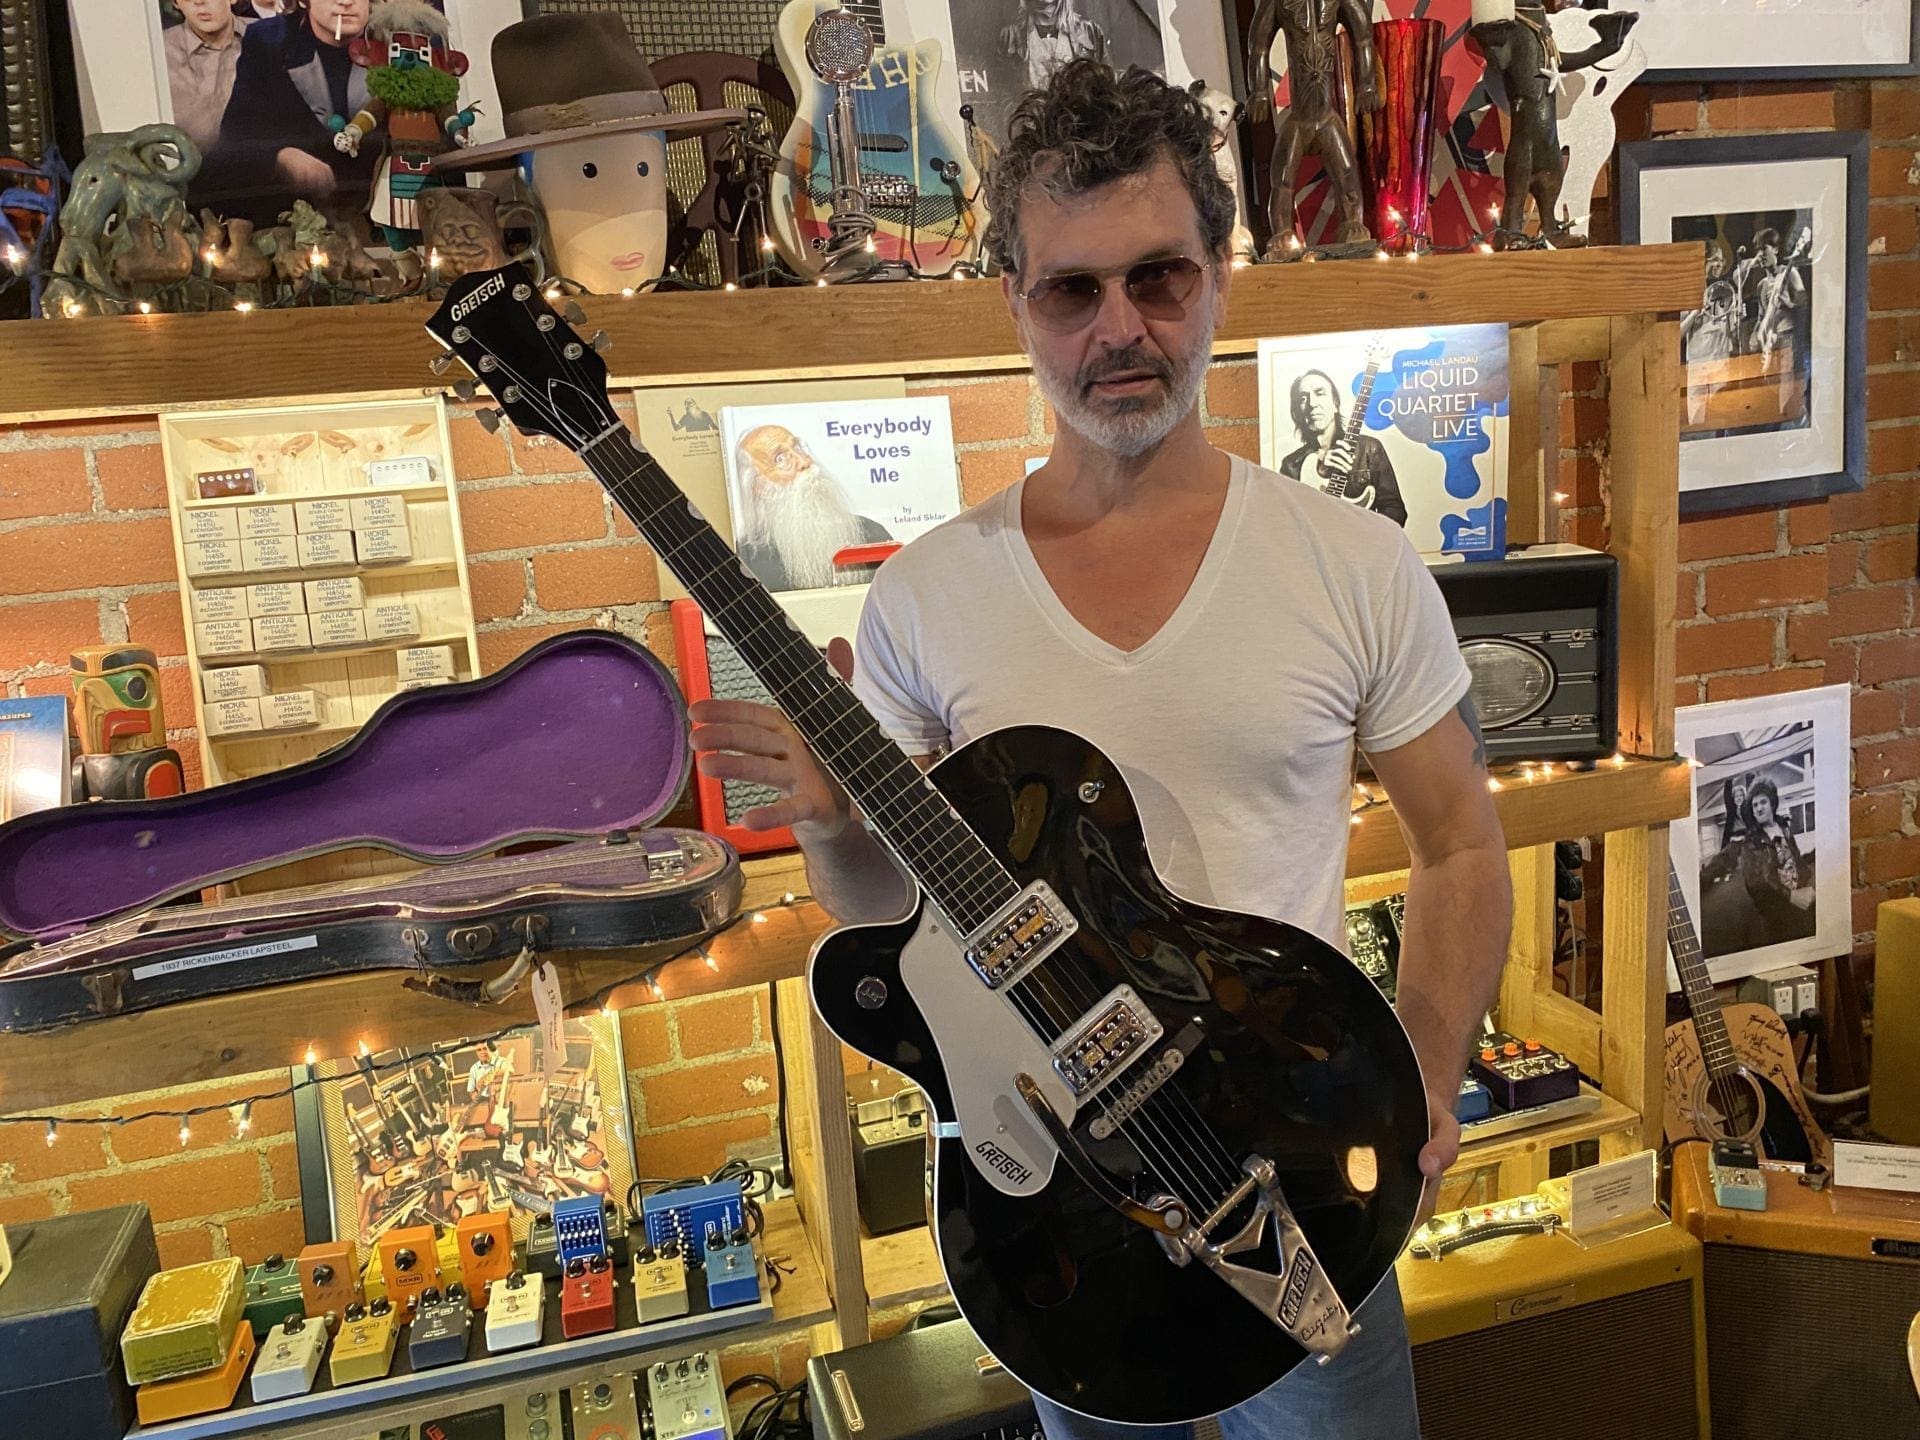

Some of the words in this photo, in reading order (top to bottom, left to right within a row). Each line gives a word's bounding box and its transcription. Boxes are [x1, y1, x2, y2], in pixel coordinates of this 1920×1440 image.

[451, 273, 505, 321] GRETSCH
[1402, 359, 1440, 368] MICHAEL
[1441, 356, 1478, 365] LANDAU
[1402, 367, 1479, 392] LIQUID
[1377, 393, 1479, 420] QUARTET
[826, 416, 932, 439] Everybody
[1433, 418, 1478, 438] LIVE
[853, 444, 911, 460] Loves
[870, 467, 900, 483] Me
[903, 506, 912, 514] by
[894, 514, 921, 524] Leland
[923, 513, 947, 521] Sklar
[255, 584, 289, 592] ANTIQUE
[317, 579, 351, 588] ANTIQUE
[198, 589, 232, 597] ANTIQUE
[376, 605, 409, 613] ANTIQUE
[320, 610, 354, 620] ANTIQUE
[205, 621, 240, 630] ANTIQUE
[260, 617, 294, 625] ANTIQUE
[0, 712, 32, 720] asures
[161, 961, 180, 971] 1937
[183, 950, 249, 967] RICKENBACKER
[251, 942, 293, 955] LAPSTEEL
[976, 1141, 1032, 1185] GRETSCH
[399, 1276, 420, 1285] MXR
[1280, 1248, 1312, 1328] GRETSCH
